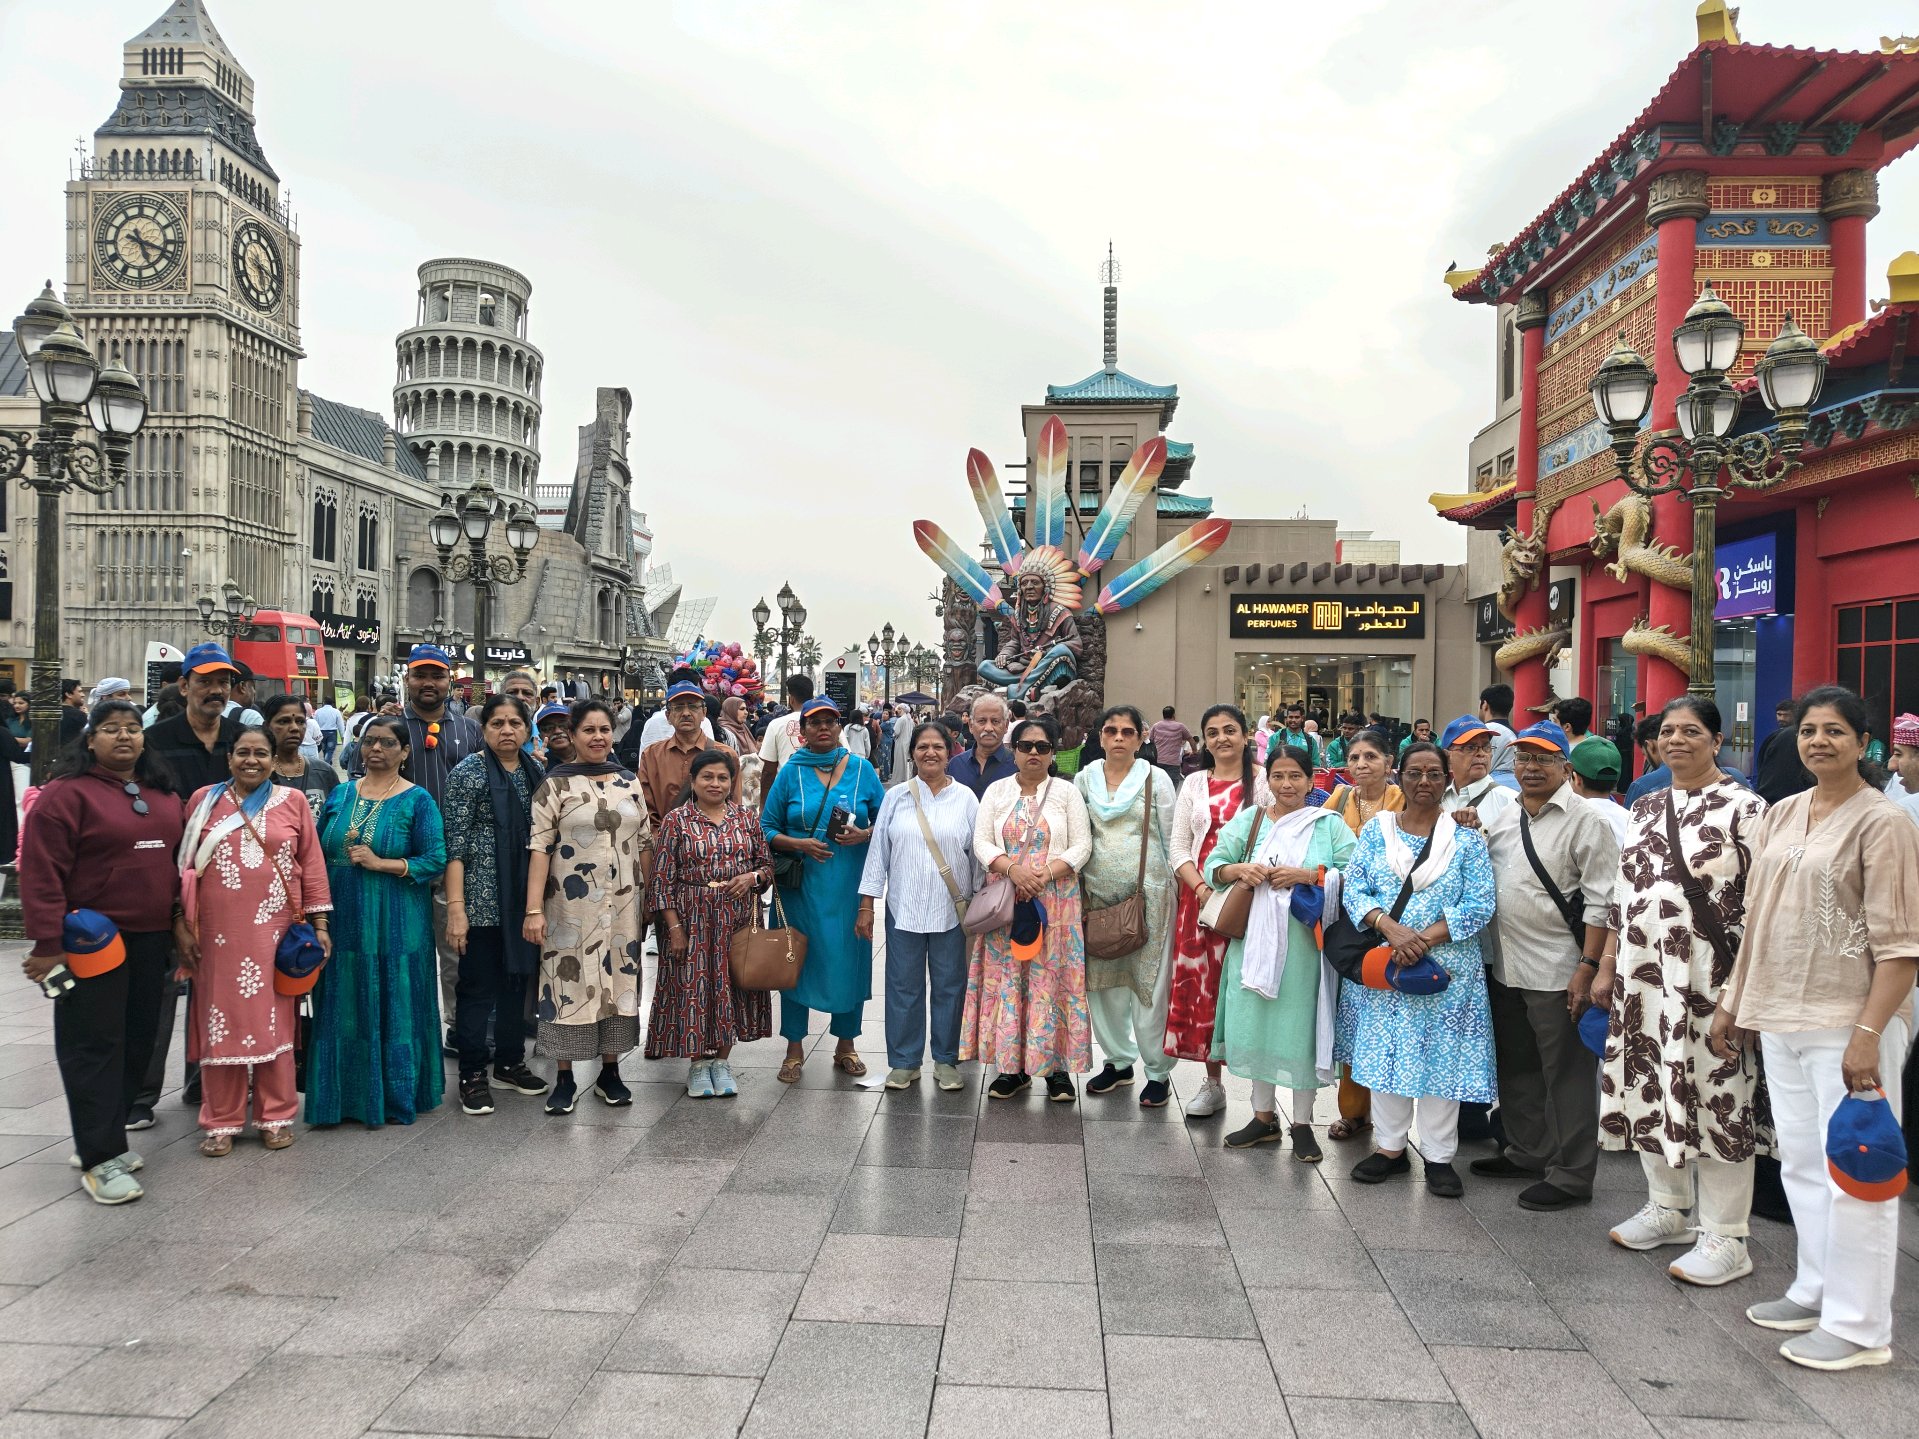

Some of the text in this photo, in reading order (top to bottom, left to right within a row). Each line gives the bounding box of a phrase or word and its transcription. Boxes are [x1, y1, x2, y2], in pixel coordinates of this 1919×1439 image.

[1733, 555, 1772, 580] باسكن
[1734, 577, 1772, 599] روبنز
[1236, 603, 1309, 614] AL HAWAMER
[320, 619, 336, 638] Abu
[1247, 619, 1298, 628] PERFUMES
[1358, 619, 1407, 631] للعطور
[487, 647, 525, 660] كارينا
